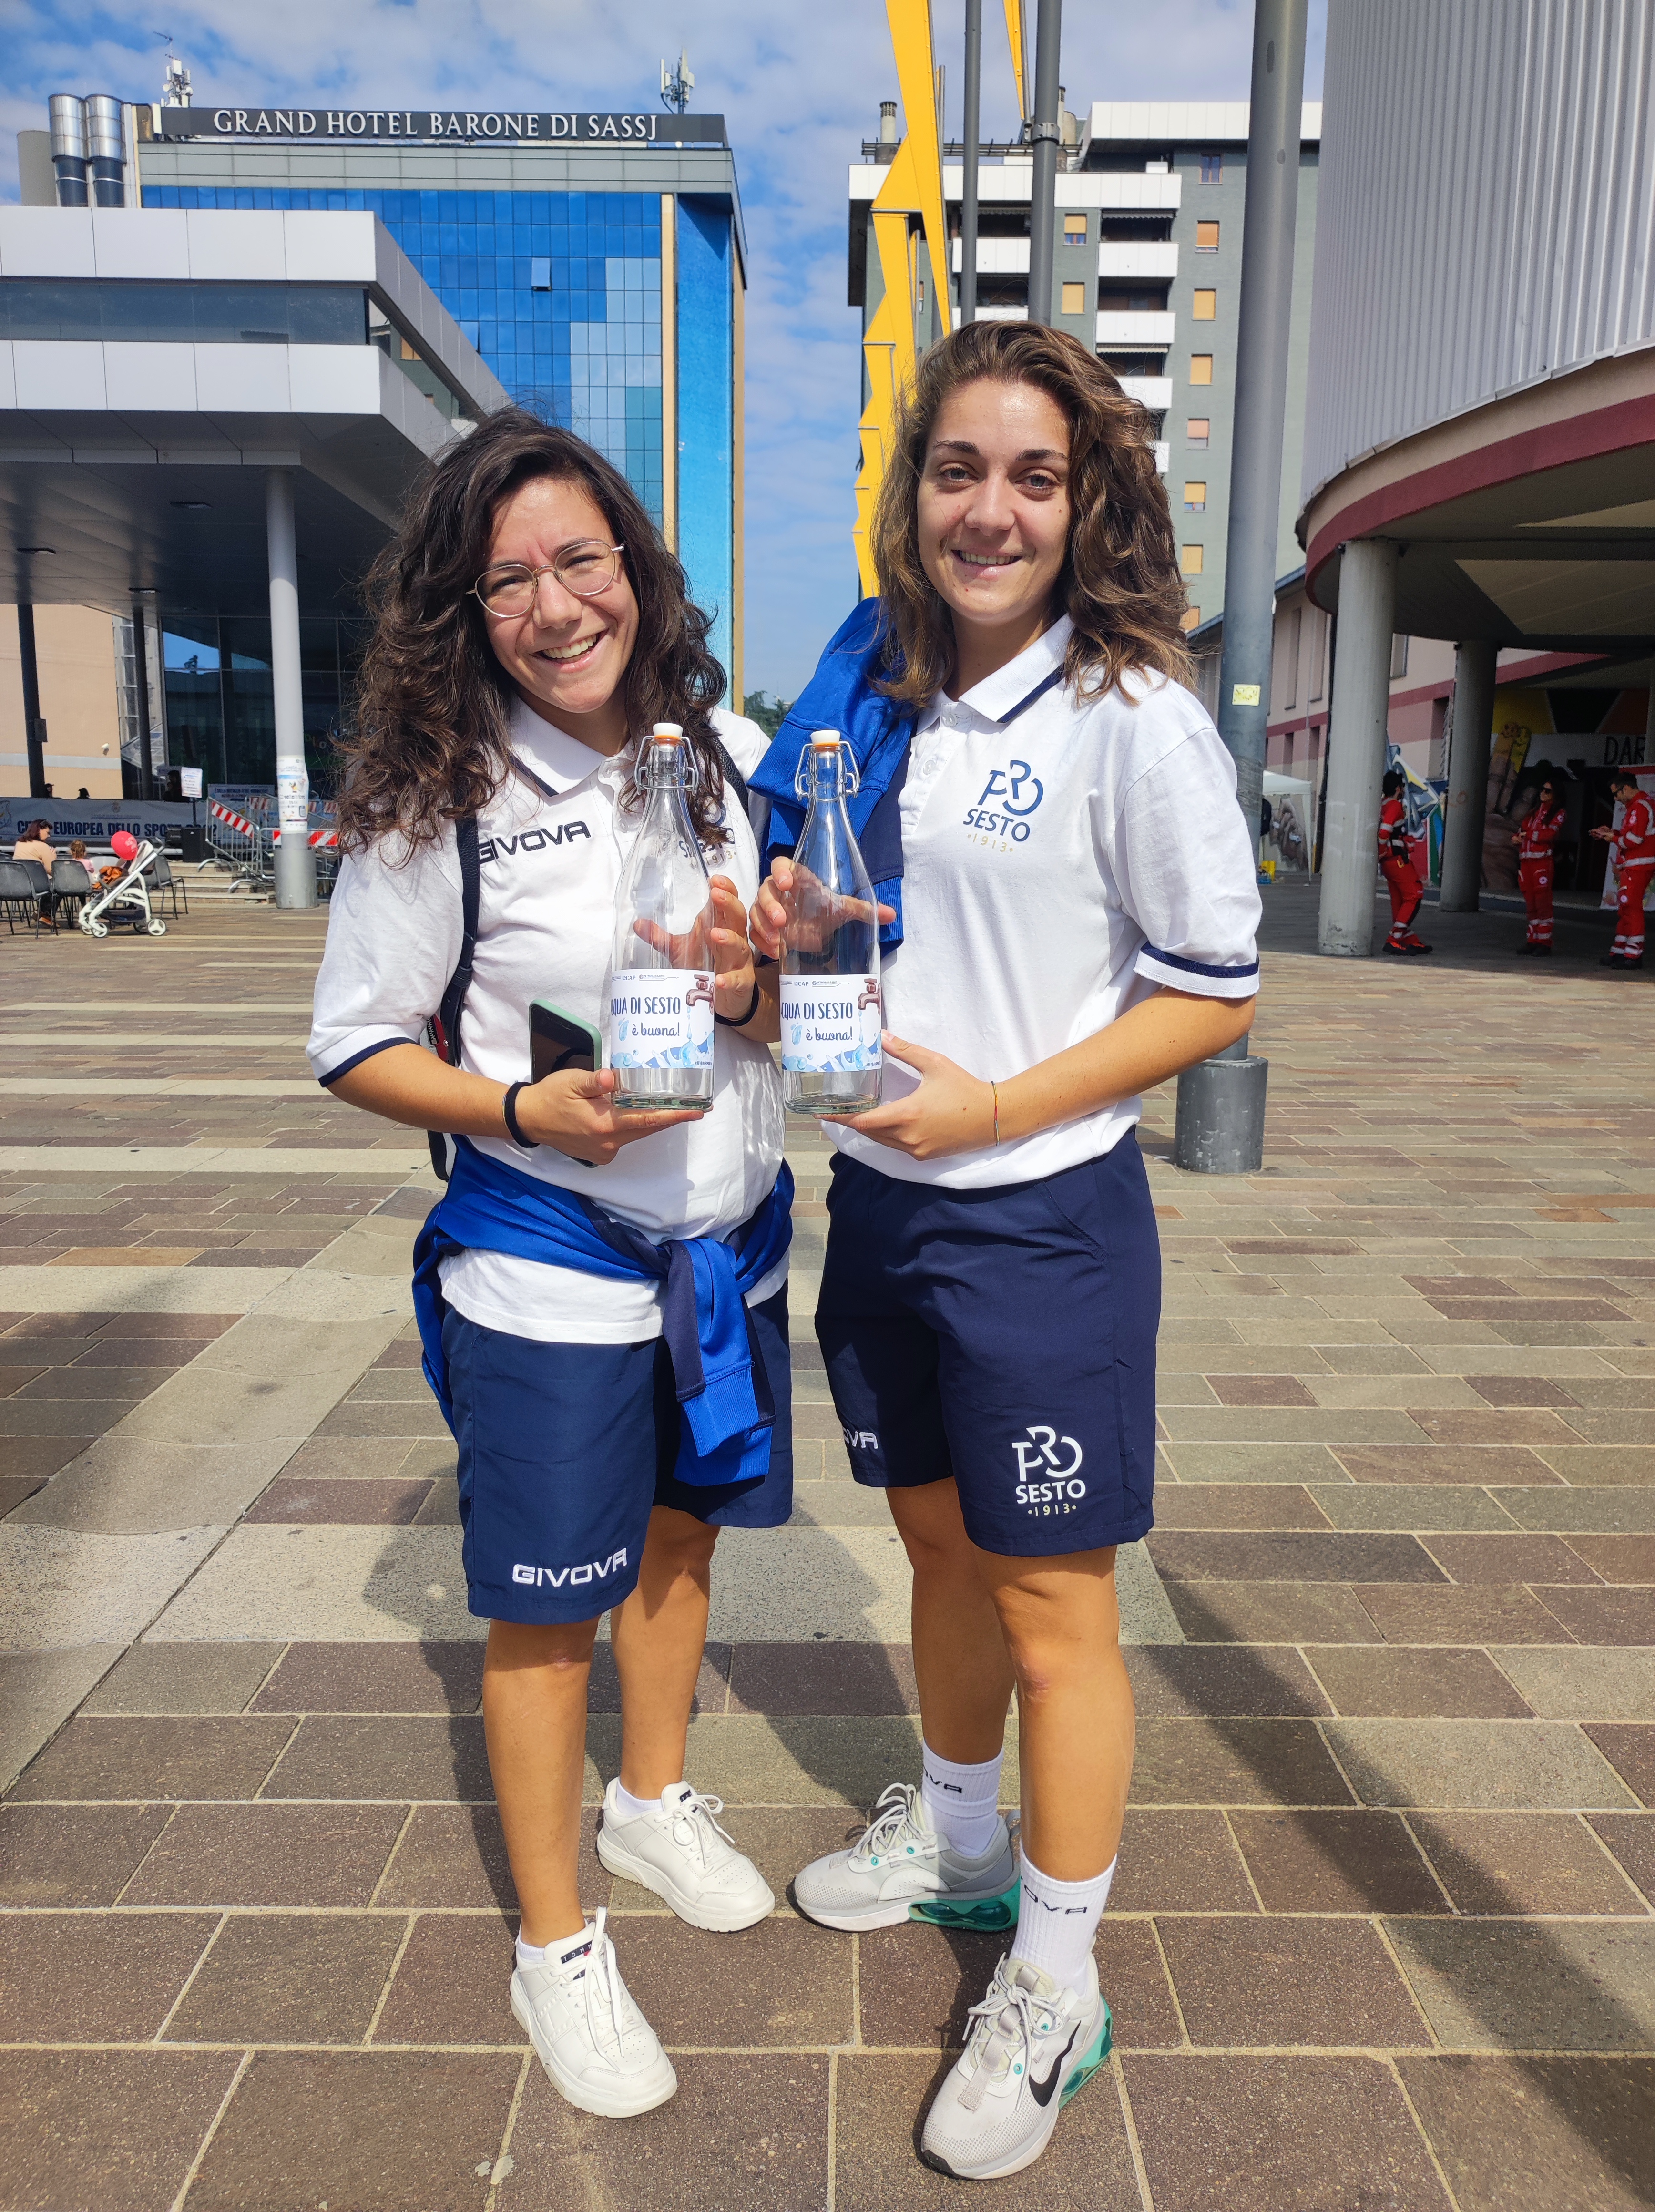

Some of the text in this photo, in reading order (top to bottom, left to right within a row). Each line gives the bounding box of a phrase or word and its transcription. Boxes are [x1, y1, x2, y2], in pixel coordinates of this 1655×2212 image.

[214, 110, 658, 141] GRAND HOTEL BARONE DI SASSJ
[53, 821, 104, 836] EUROPEA
[108, 822, 140, 837] DELLO
[144, 823, 182, 837] SPO
[963, 809, 1031, 842] SESTO
[630, 997, 641, 1014] DI
[644, 997, 681, 1014] SESTO
[780, 1002, 853, 1021] CQUA DI SESTO
[632, 1022, 680, 1036] è buona!
[806, 1026, 853, 1041] è buona!
[1015, 1479, 1086, 1504] SESTO
[512, 1547, 627, 1587] GIVOVA
[563, 1943, 592, 1962] TOMM
